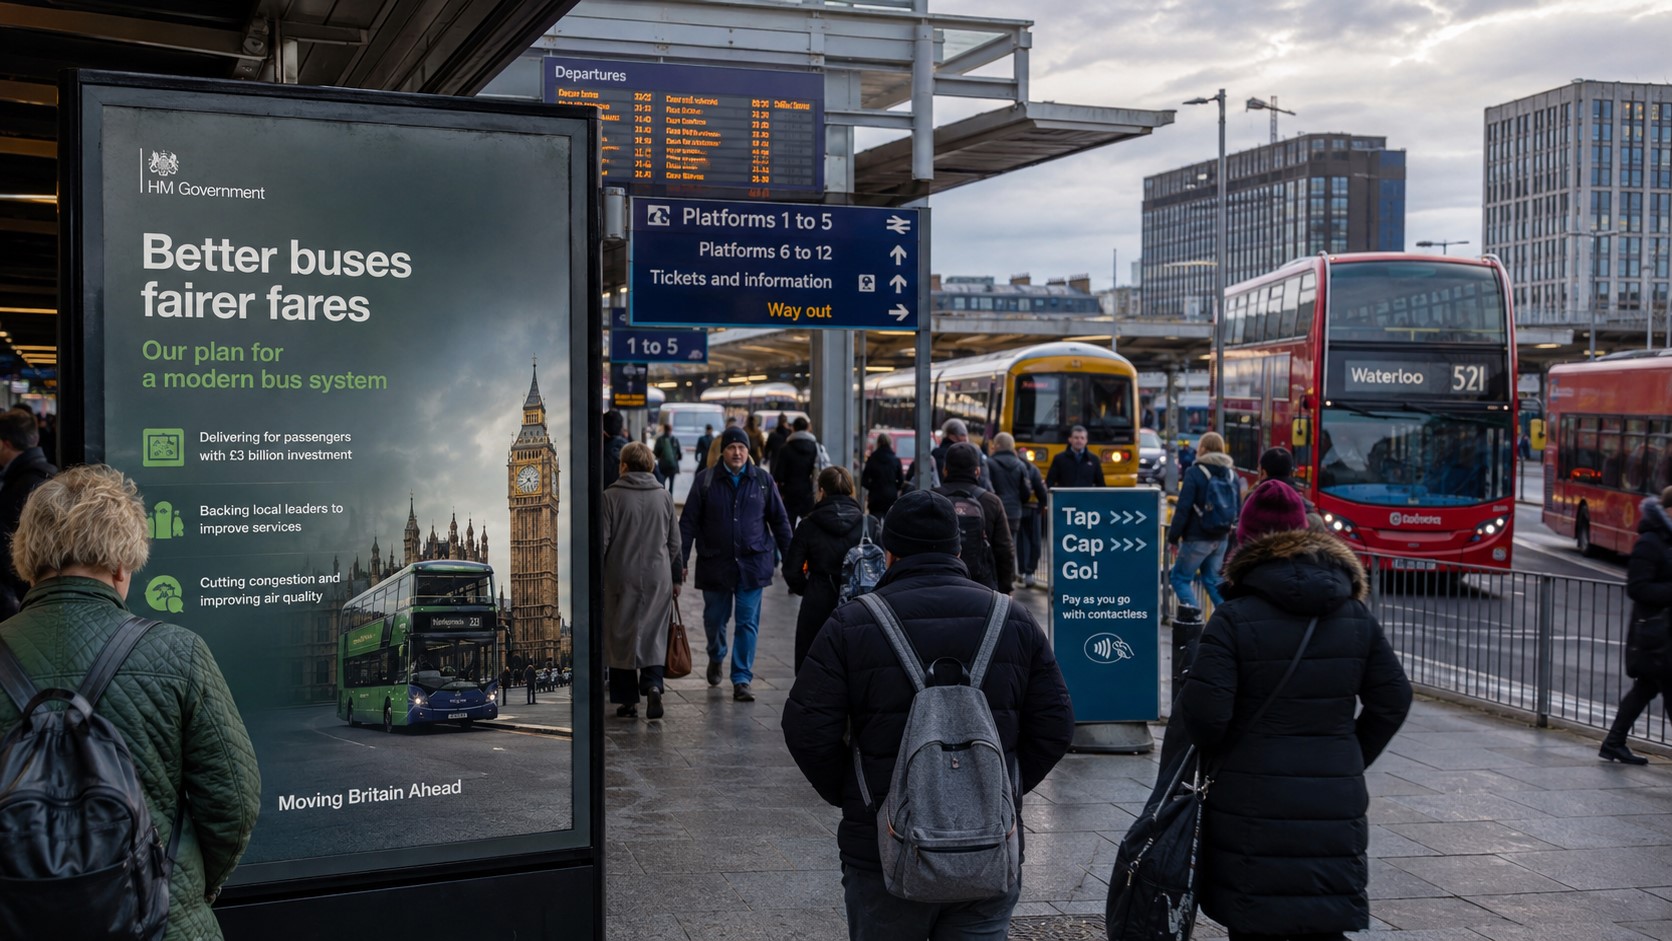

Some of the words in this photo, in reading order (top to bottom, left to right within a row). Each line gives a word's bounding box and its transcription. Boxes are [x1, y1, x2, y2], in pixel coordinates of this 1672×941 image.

[555, 65, 627, 83] Departures
[148, 179, 174, 195] HM
[178, 181, 266, 200] Government
[683, 207, 776, 229] Platforms
[781, 211, 789, 229] 1
[795, 213, 816, 230] to
[821, 212, 833, 231] 5
[144, 232, 277, 273] Better
[291, 240, 411, 278] buses
[699, 241, 776, 259] Platforms
[779, 244, 791, 259] 6
[794, 245, 812, 260] to
[815, 245, 833, 261] 12
[649, 269, 707, 286] Tickets
[710, 271, 740, 287] and
[744, 271, 833, 289] information
[141, 281, 255, 319] fairer
[266, 285, 370, 322] fares
[767, 301, 802, 321] Way
[805, 304, 832, 319] out
[142, 339, 188, 361] Our
[194, 340, 244, 366] plan
[250, 342, 284, 362] for
[627, 337, 636, 355] 1
[642, 338, 662, 355] to
[667, 337, 679, 355] 5
[142, 372, 157, 388] a
[164, 368, 254, 389] modern
[261, 369, 303, 389] bus
[309, 372, 388, 394] system
[1350, 367, 1424, 385] Waterloo
[1452, 365, 1485, 392] 521
[199, 431, 261, 445] Delivering
[263, 431, 282, 443] for
[283, 433, 352, 445] passengers
[199, 449, 226, 461] with
[229, 449, 245, 461] £3
[248, 449, 284, 461] billion
[287, 449, 353, 461] investment
[200, 504, 250, 518] Backing
[253, 503, 282, 515] local
[285, 502, 329, 515] leaders
[330, 503, 344, 514] to
[1061, 507, 1101, 530] Tap
[200, 522, 250, 537] improve
[252, 521, 302, 533] services
[1061, 533, 1104, 557] Cap
[200, 576, 246, 590] Cutting
[248, 573, 316, 588] congestion
[318, 571, 341, 584] and
[1062, 561, 1099, 580] Go!
[200, 593, 261, 609] improving
[264, 592, 280, 604] air
[282, 590, 323, 605] quality
[1062, 594, 1082, 607] Pay
[1082, 596, 1095, 605] as
[1096, 596, 1116, 606] you
[1117, 596, 1131, 606] go
[1062, 609, 1086, 620] with
[1087, 608, 1148, 620] contactless
[278, 792, 343, 811] Moving
[348, 785, 404, 805] Britain
[408, 778, 462, 799] Ahead
